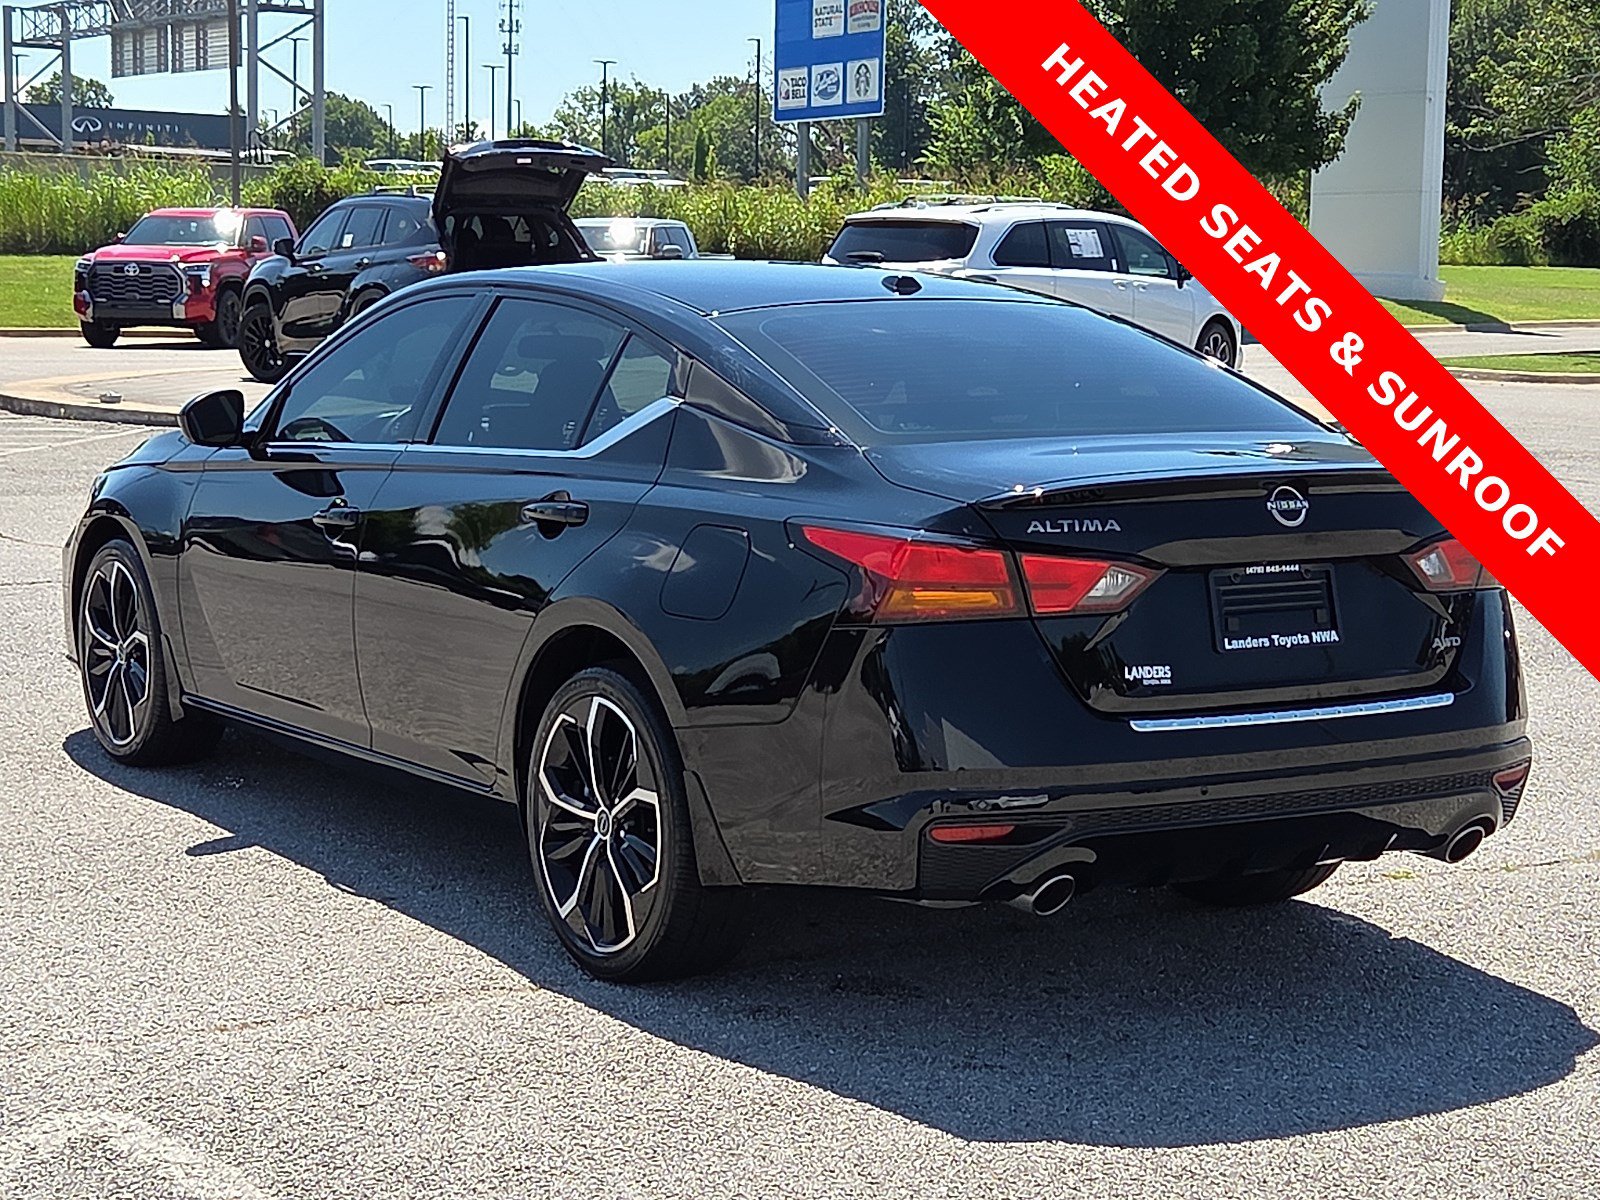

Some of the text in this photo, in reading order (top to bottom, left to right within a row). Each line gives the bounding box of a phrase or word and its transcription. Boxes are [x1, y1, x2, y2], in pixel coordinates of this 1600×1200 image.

[815, 5, 843, 16] NATURAL
[814, 17, 833, 28] STATE
[790, 77, 807, 88] TACO
[791, 88, 806, 99] BELL
[109, 121, 179, 133] INFINITI
[1266, 500, 1309, 510] NISSAN
[1026, 519, 1121, 534] ALTIMA
[1224, 630, 1339, 650] Landers Toyota NWA
[1124, 665, 1172, 681] LANDERS
